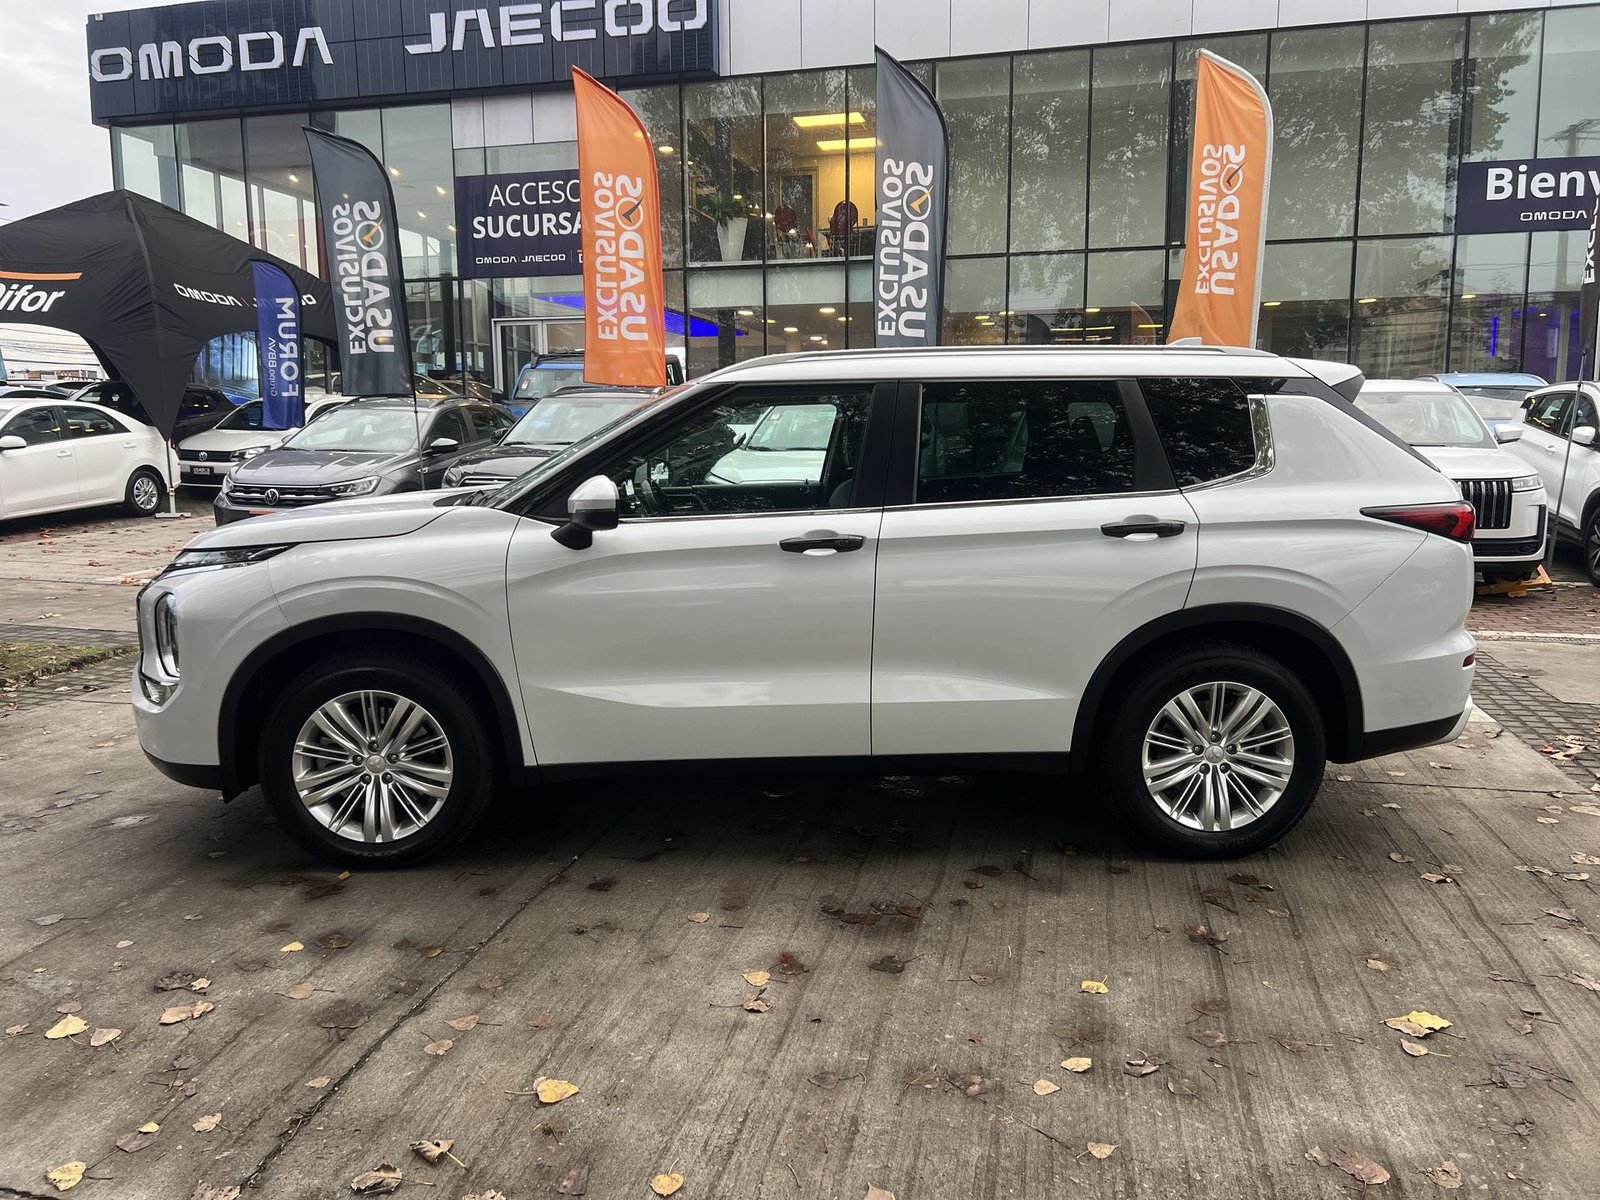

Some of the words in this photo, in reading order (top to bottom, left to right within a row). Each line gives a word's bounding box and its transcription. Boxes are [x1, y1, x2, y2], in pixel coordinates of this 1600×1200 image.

[91, 26, 334, 82] OMODA
[404, 0, 708, 54] JAECOO
[1520, 210, 1588, 221] OMODA
[475, 256, 517, 264] OMODA
[521, 253, 566, 263] JAECOO
[0, 282, 65, 312] ifor
